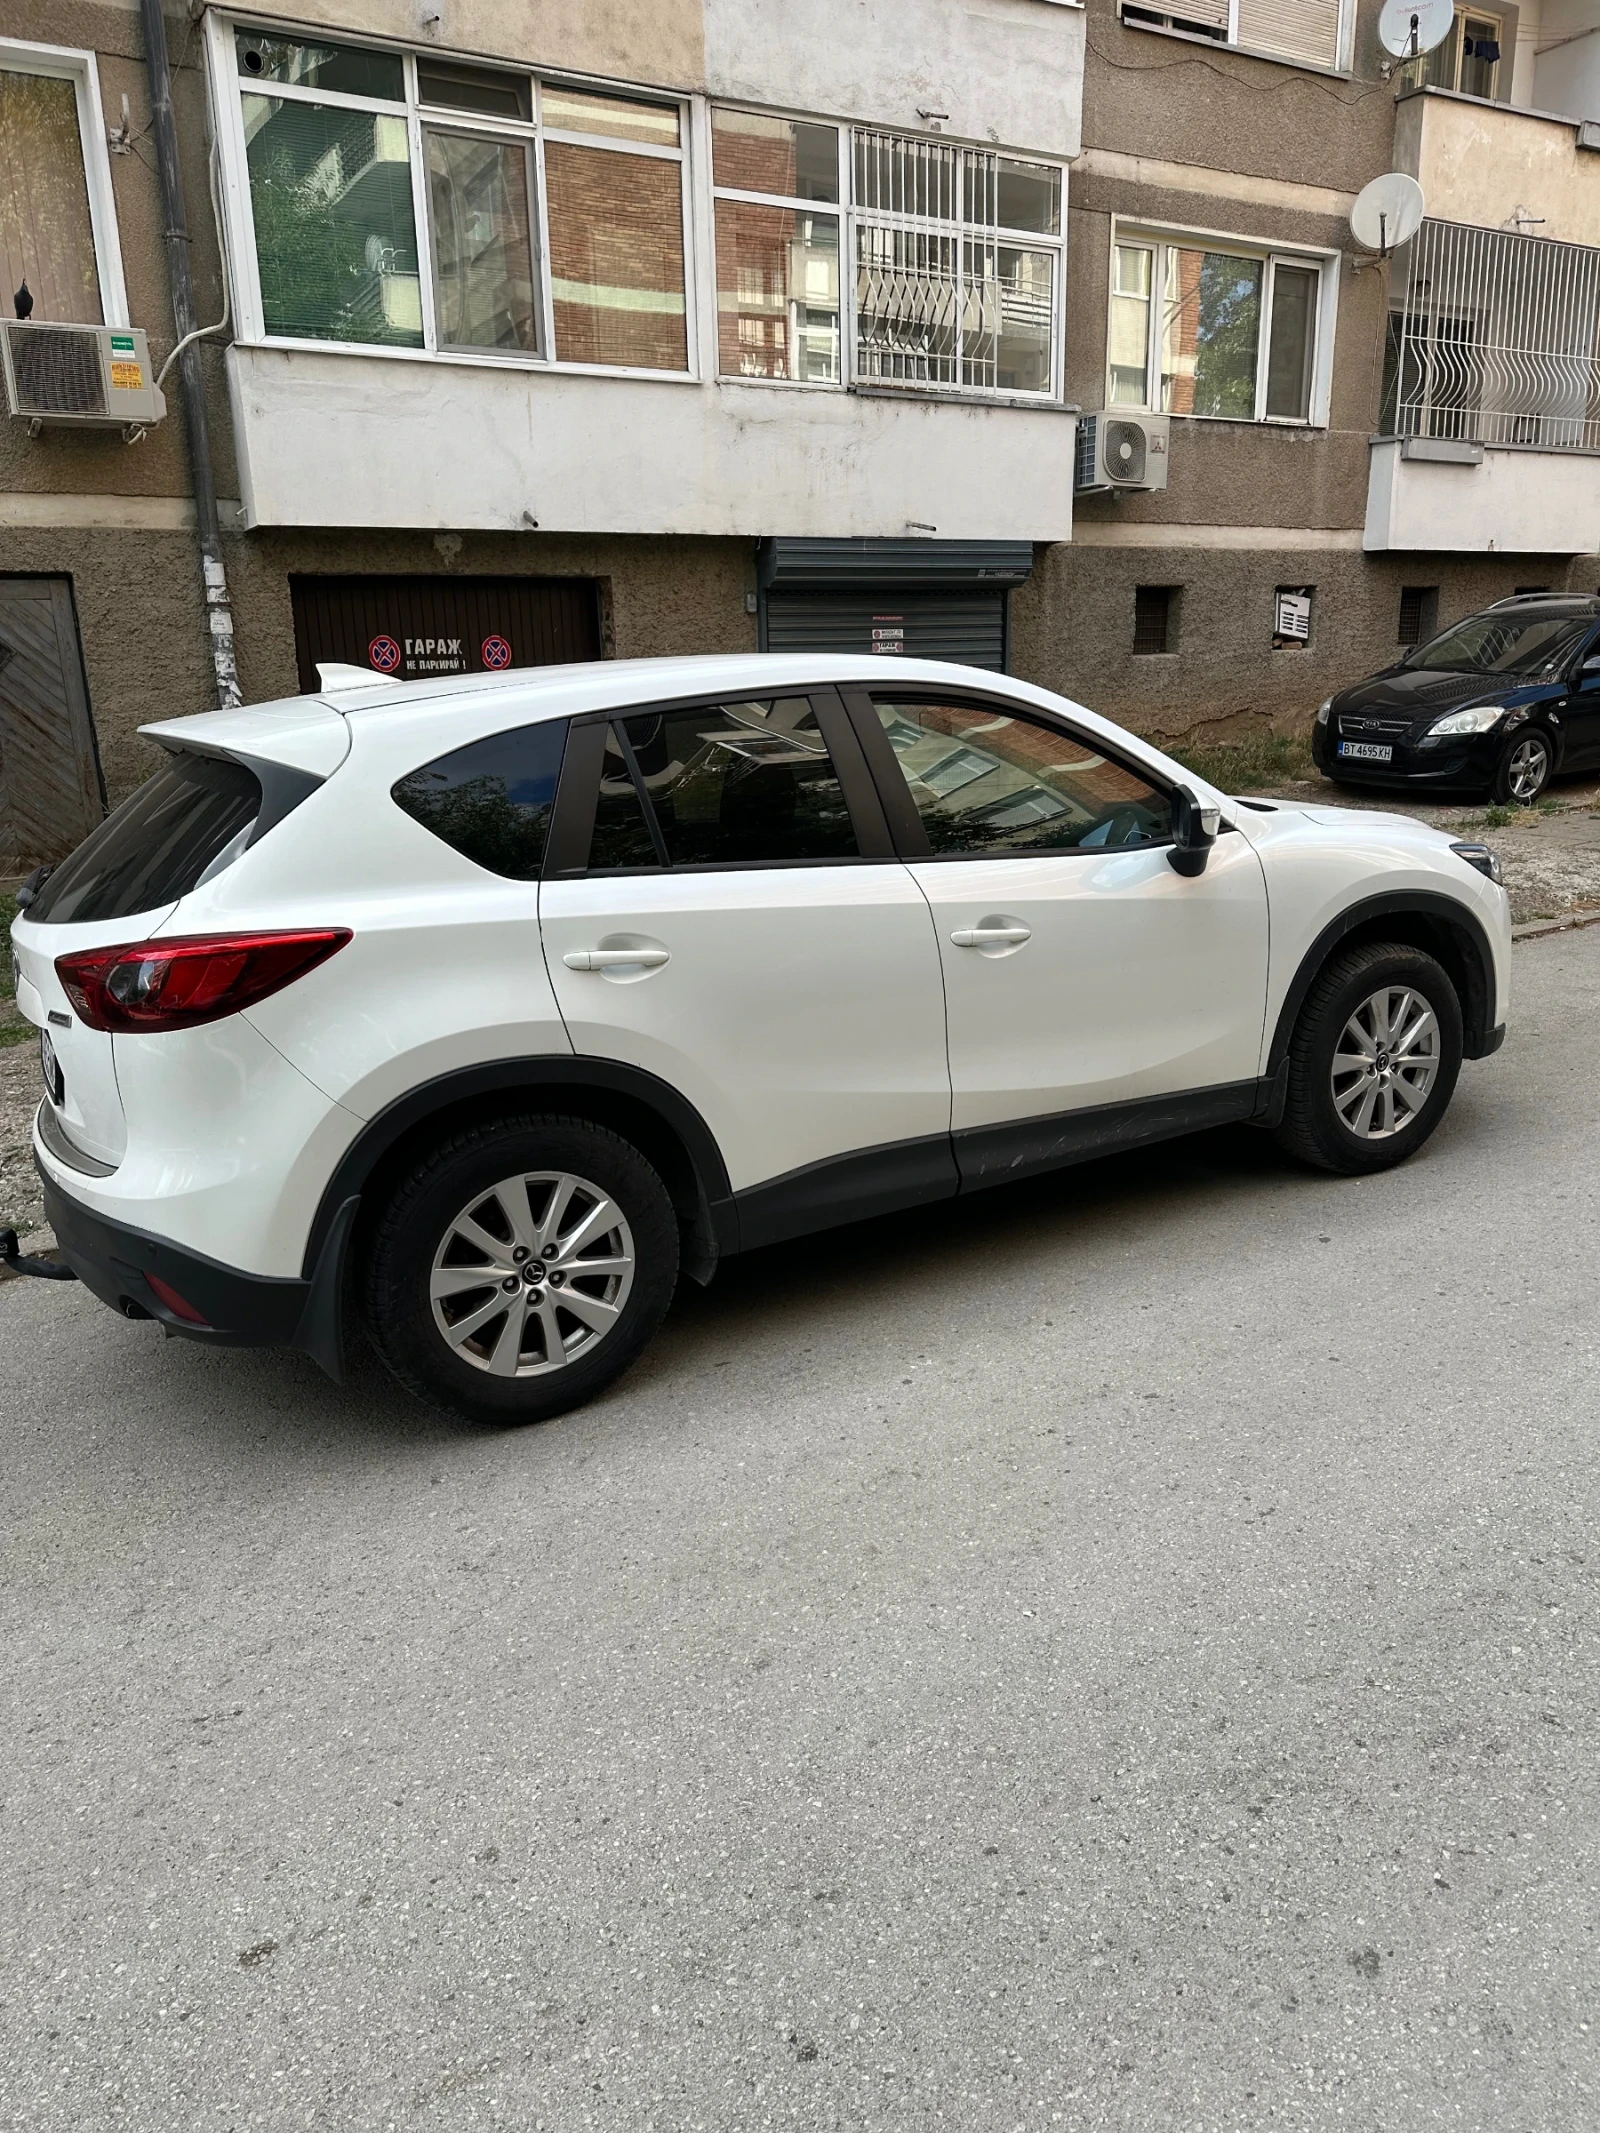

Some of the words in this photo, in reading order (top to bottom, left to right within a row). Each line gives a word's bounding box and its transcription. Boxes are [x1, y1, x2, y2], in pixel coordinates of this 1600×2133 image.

[405, 639, 463, 655] ГАРАЖ
[406, 660, 416, 670] НЕ
[419, 658, 460, 670] ПАРКИРАЙ
